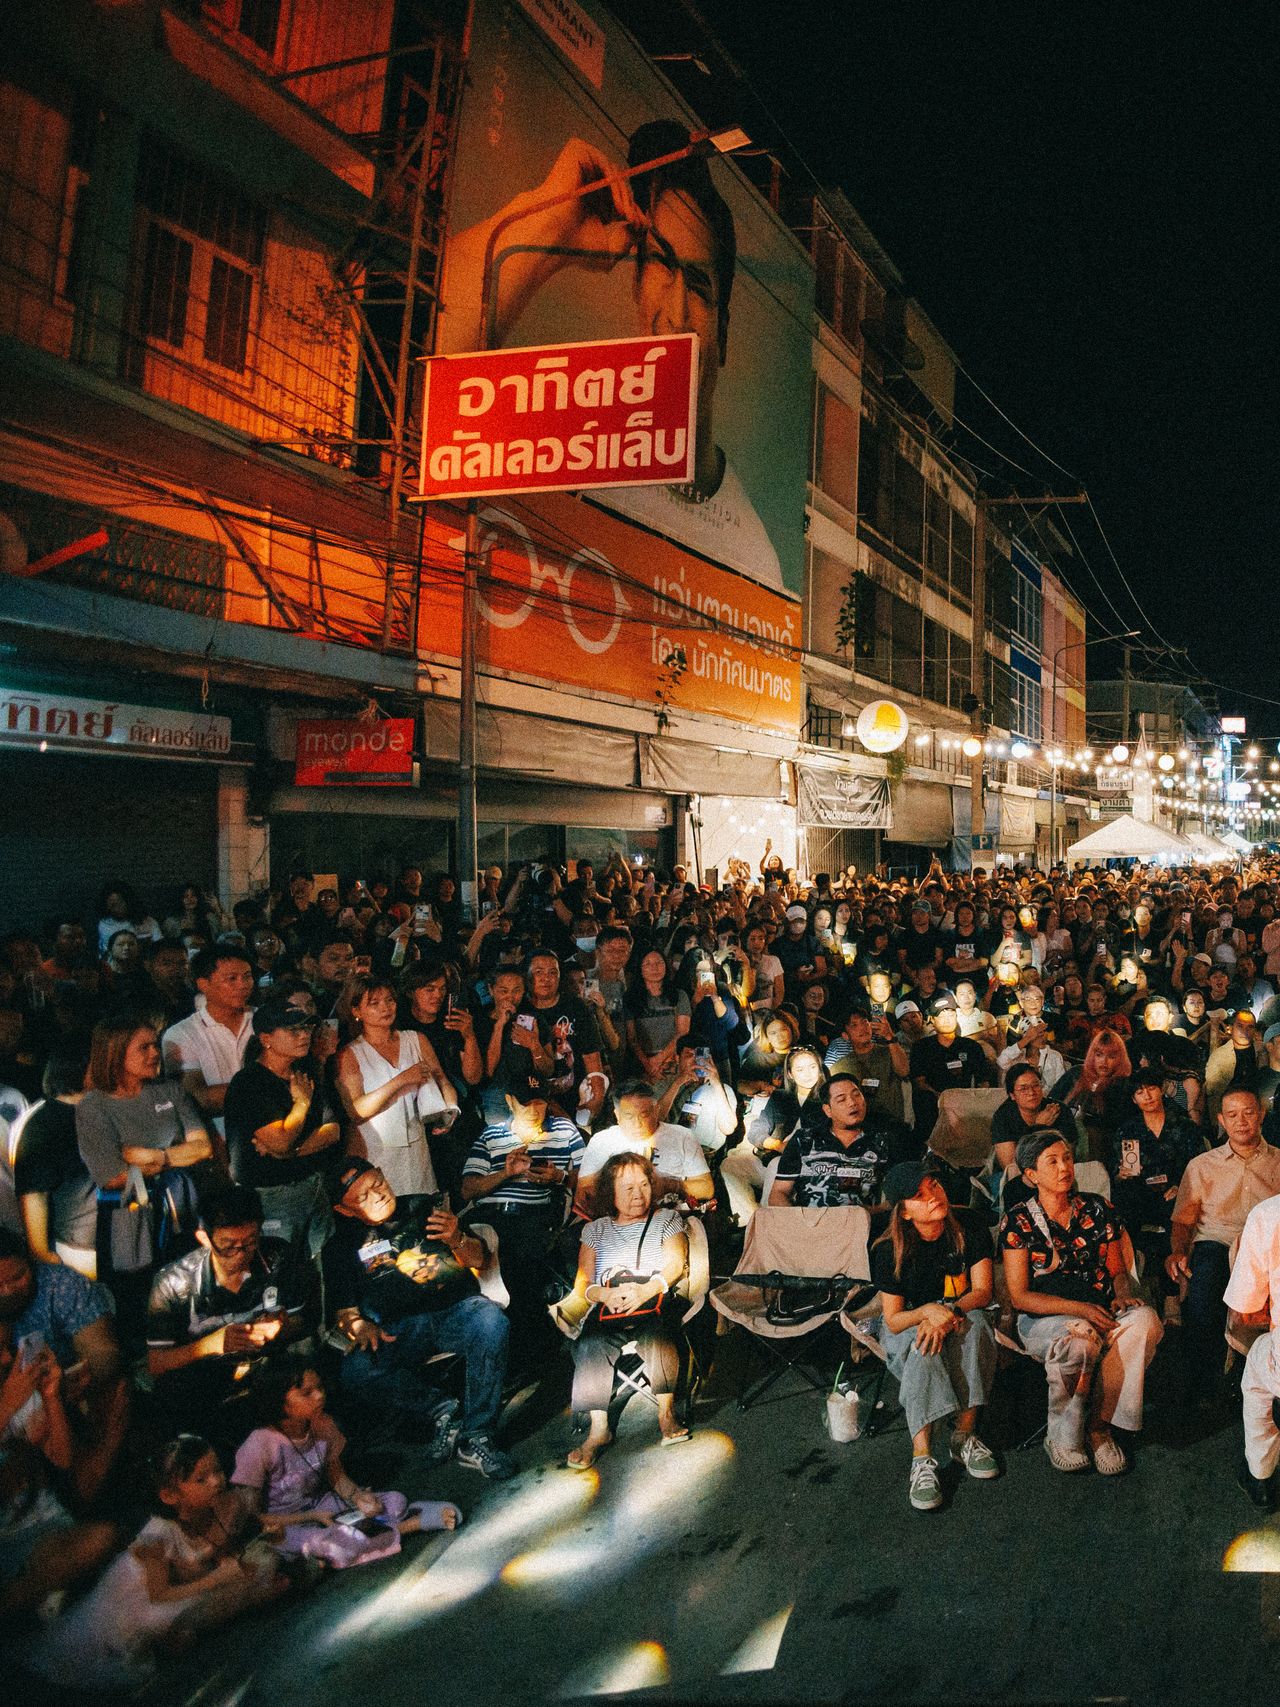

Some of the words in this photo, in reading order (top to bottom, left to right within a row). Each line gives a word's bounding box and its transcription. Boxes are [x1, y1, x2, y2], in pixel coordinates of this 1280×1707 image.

[458, 346, 667, 418] อาทิตย์
[429, 410, 687, 482] คัลเลอร์แล็บ
[692, 638, 792, 703] นักทัศนมาตร
[305, 725, 405, 752] monde
[979, 835, 988, 849] P
